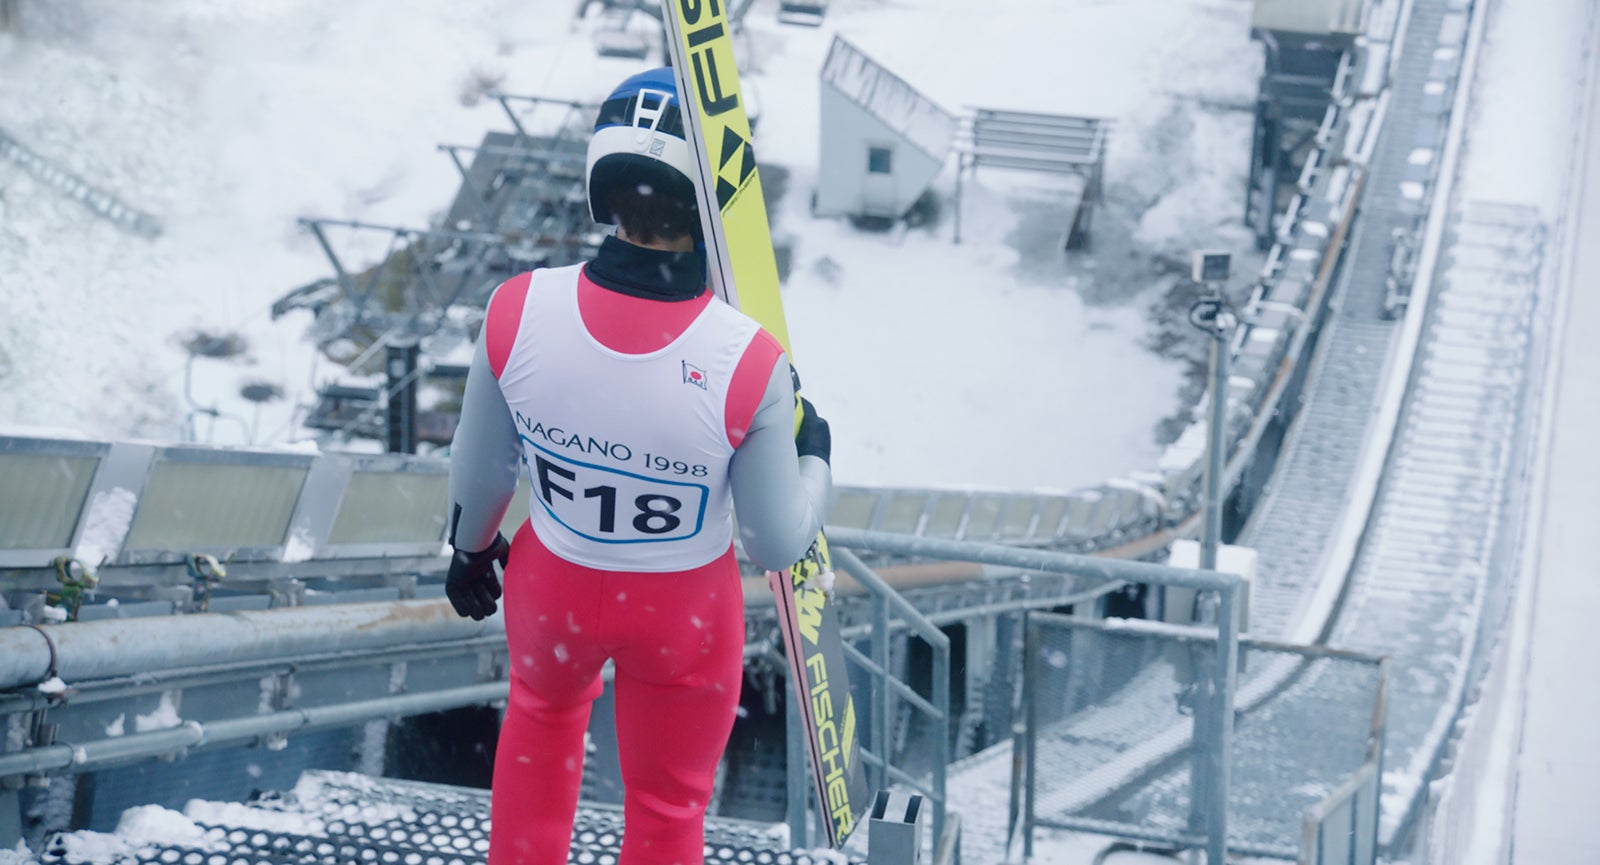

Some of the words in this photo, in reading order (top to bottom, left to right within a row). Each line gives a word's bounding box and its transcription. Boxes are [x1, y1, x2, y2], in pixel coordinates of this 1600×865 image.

[516, 410, 632, 461] NAGANO
[644, 453, 708, 477] 1998
[535, 454, 682, 534] F18
[806, 652, 853, 842] FISCHER
